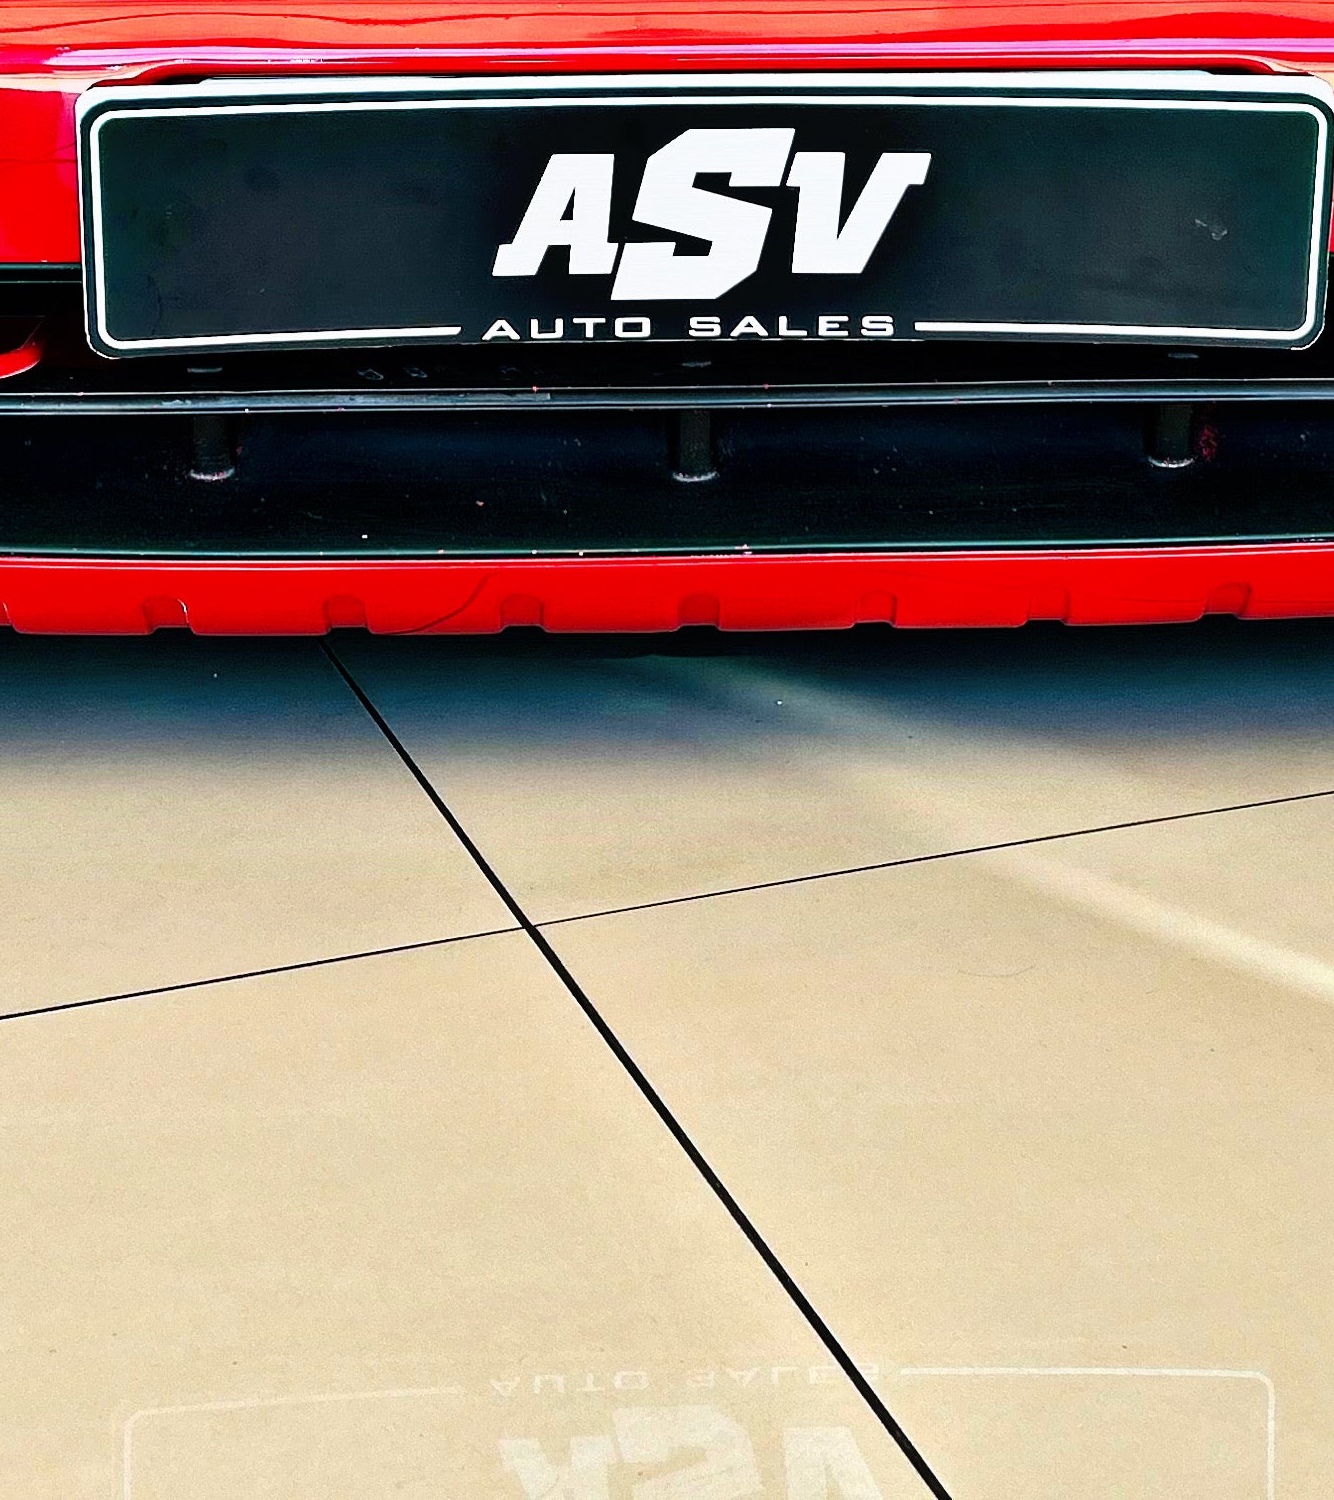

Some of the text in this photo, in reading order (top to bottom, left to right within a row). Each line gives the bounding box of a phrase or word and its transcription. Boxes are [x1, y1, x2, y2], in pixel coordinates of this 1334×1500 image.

[492, 128, 932, 300] ASV
[481, 315, 895, 341] AUTO SALES
